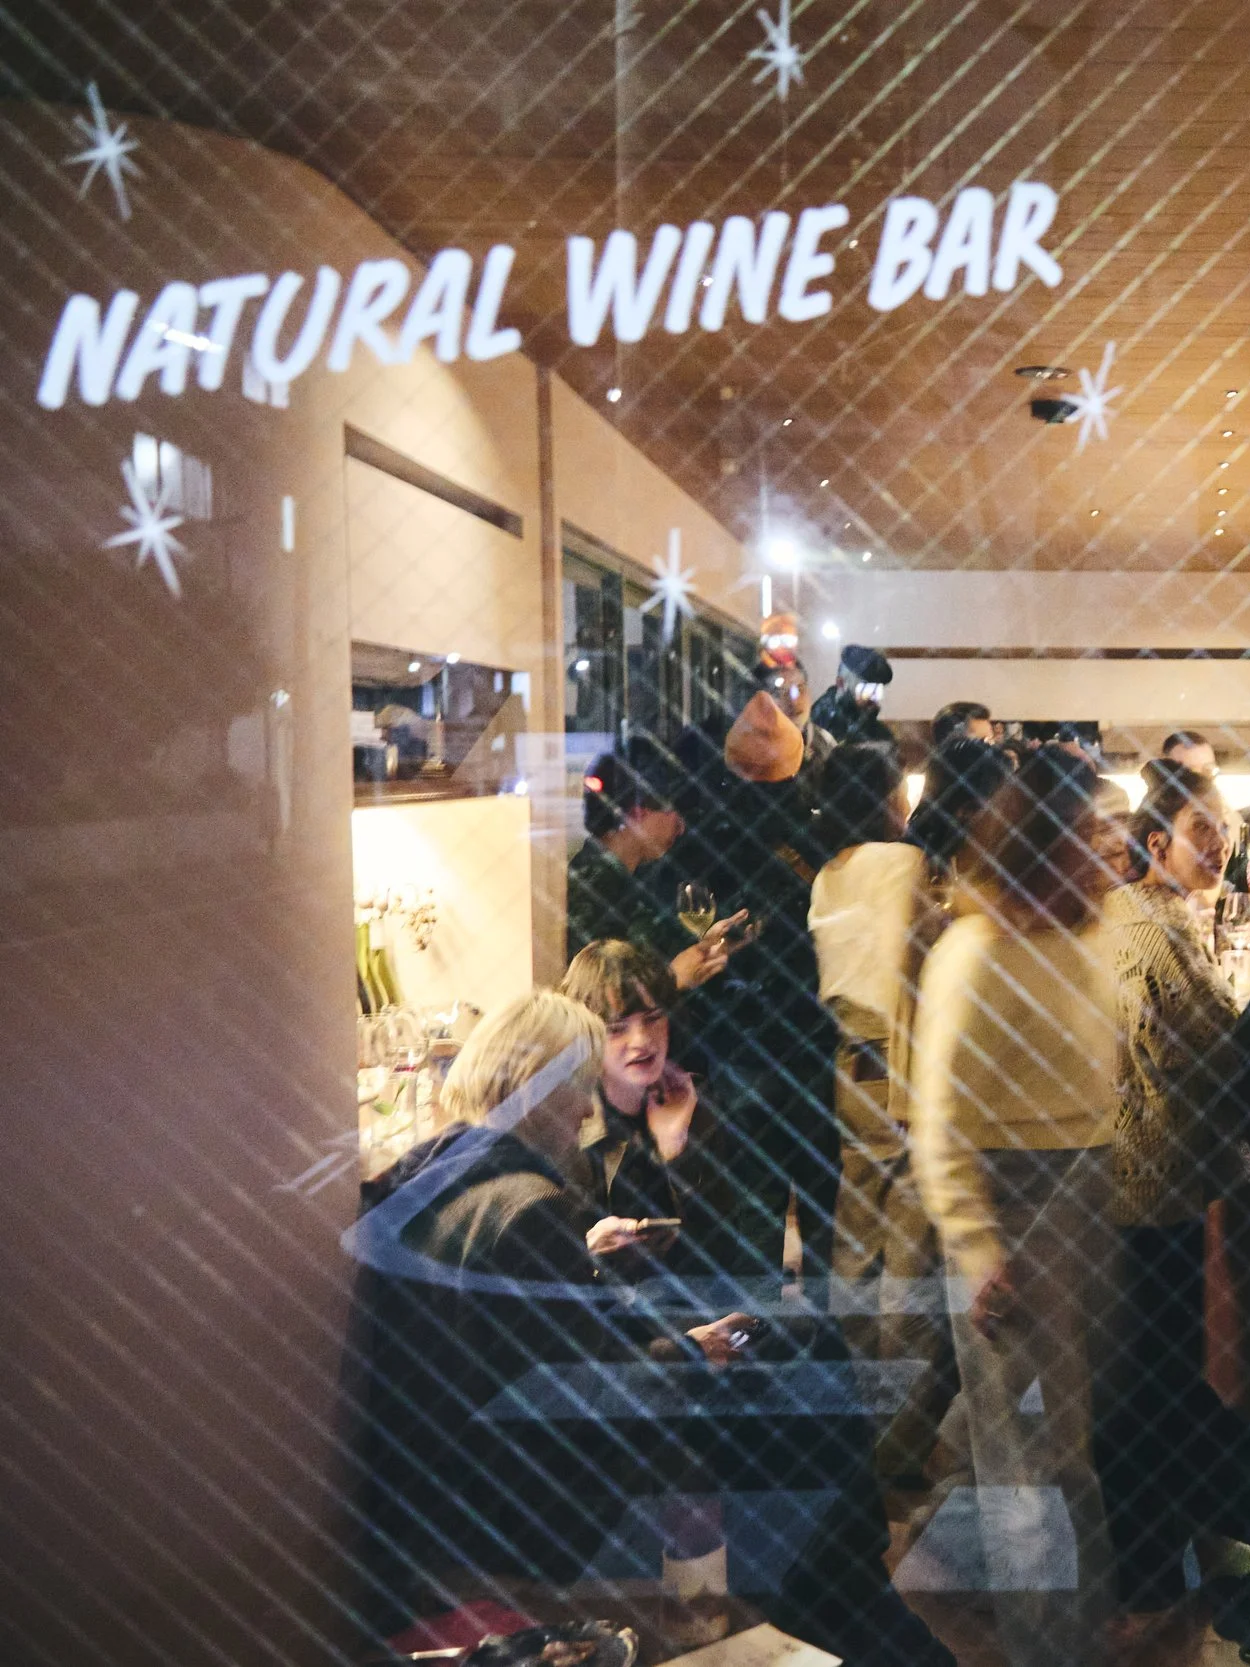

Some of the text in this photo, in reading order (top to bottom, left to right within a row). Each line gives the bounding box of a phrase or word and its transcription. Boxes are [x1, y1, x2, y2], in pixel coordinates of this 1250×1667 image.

[36, 180, 1064, 411] NATURAL WINE BAR
